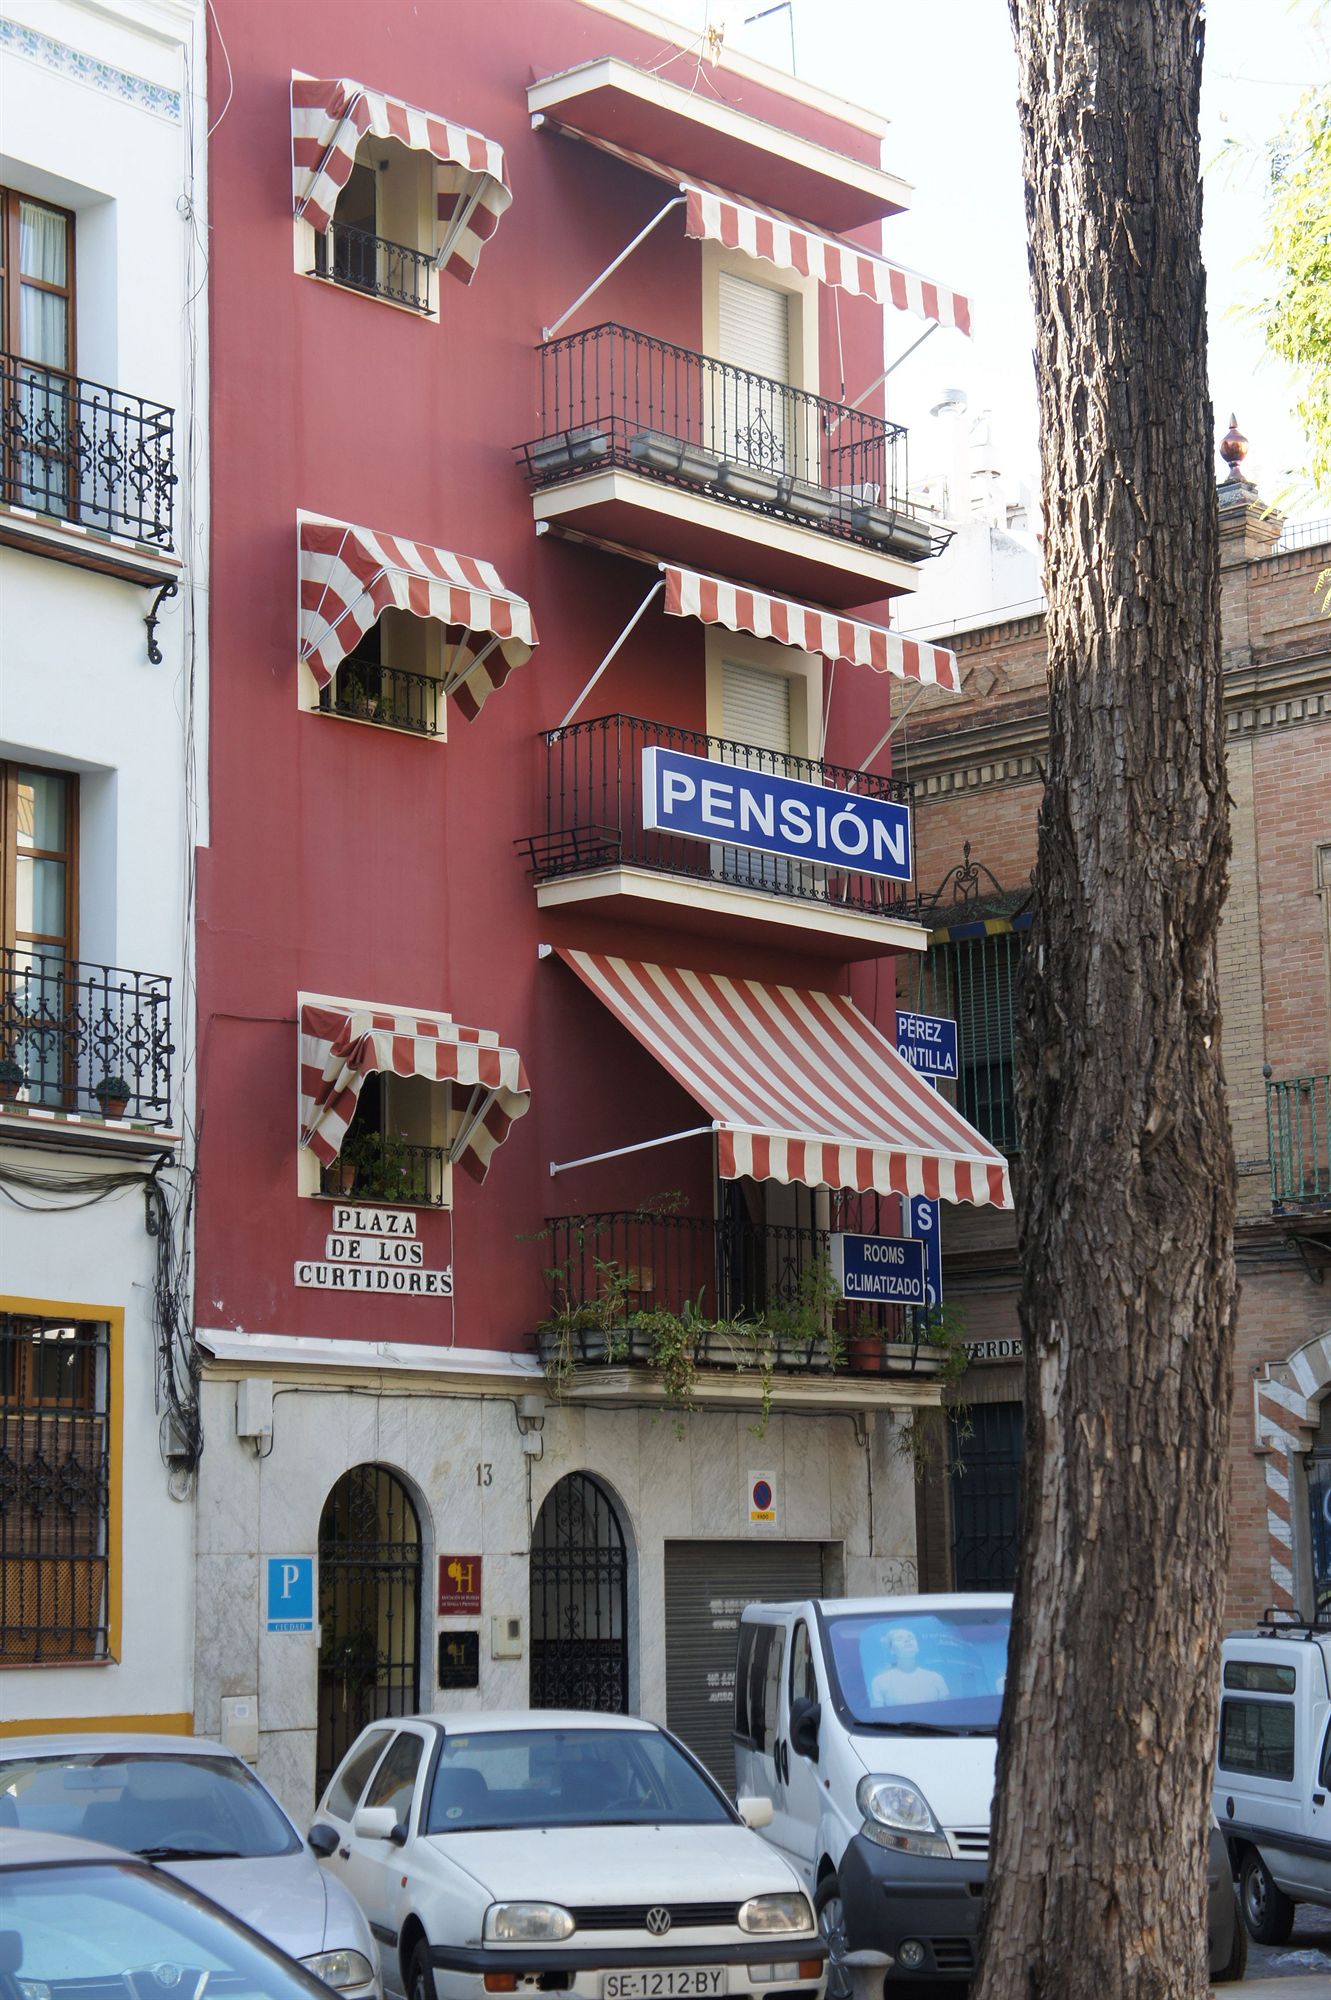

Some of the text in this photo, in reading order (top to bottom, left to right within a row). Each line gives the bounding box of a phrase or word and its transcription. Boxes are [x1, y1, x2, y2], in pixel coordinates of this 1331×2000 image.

[662, 769, 906, 866] PENSIÓN
[898, 1014, 942, 1043] PÉREZ
[898, 1044, 954, 1072] ONTILLA
[337, 1210, 415, 1234] PLAZA
[332, 1239, 422, 1264] DE LOS
[863, 1243, 905, 1265] ROOMS
[299, 1265, 452, 1294] CURTIDORES
[846, 1272, 920, 1297] CLIMATIZADO
[476, 1463, 493, 1487] 13
[280, 1564, 300, 1599] P
